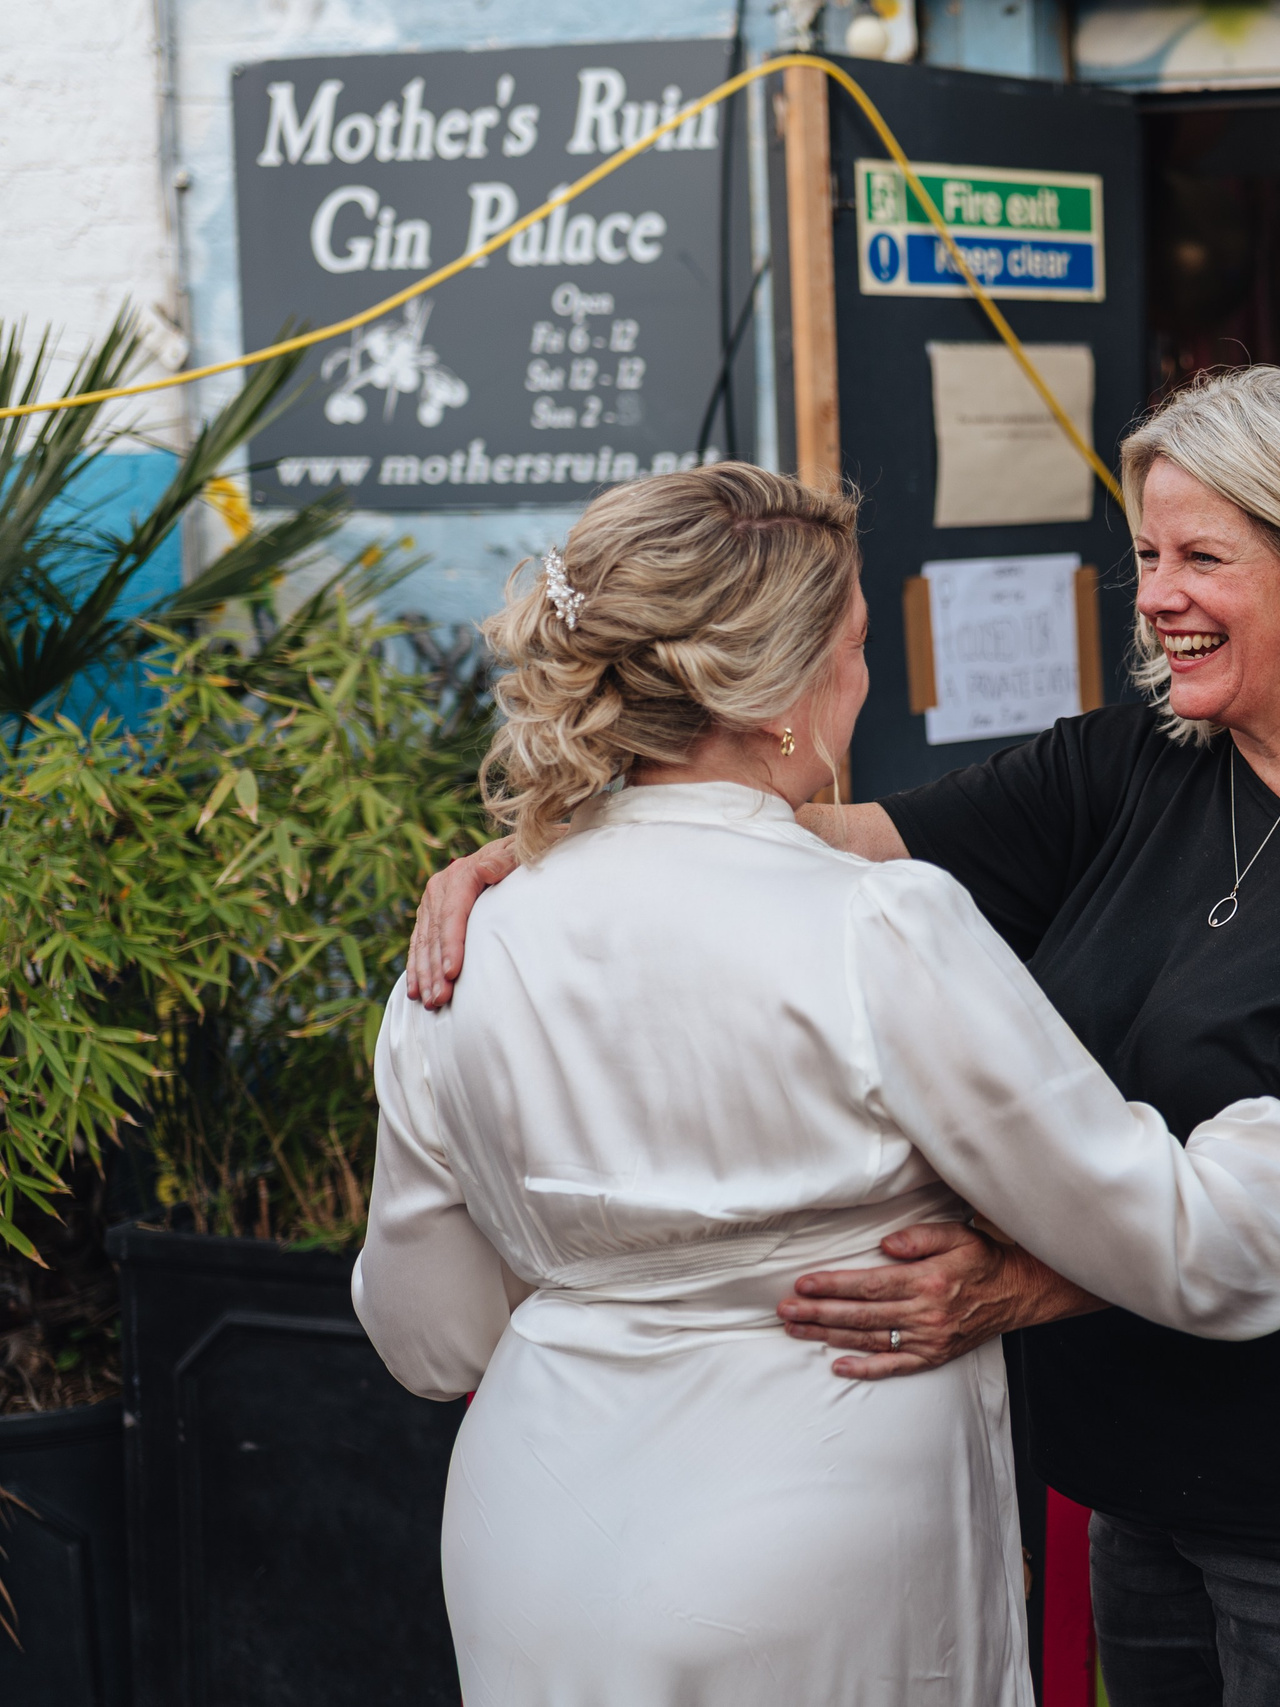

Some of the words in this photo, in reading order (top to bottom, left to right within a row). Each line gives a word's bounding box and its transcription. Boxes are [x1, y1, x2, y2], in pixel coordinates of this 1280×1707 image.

[257, 75, 539, 167] Mother's
[566, 67, 719, 155] Ruin
[942, 180, 1003, 226] Fire
[1006, 186, 1061, 230] exit
[310, 184, 432, 274] Gin
[464, 181, 668, 268] Palace
[1006, 242, 1072, 280] clear
[551, 281, 615, 325] Open
[530, 320, 566, 354] Fri
[568, 322, 591, 354] 6
[609, 318, 640, 352] 12
[525, 358, 566, 392] Sat
[568, 357, 598, 391] 12
[616, 356, 647, 390] 12
[531, 395, 577, 430] Sun
[580, 395, 603, 428] 2
[276, 455, 372, 487] www
